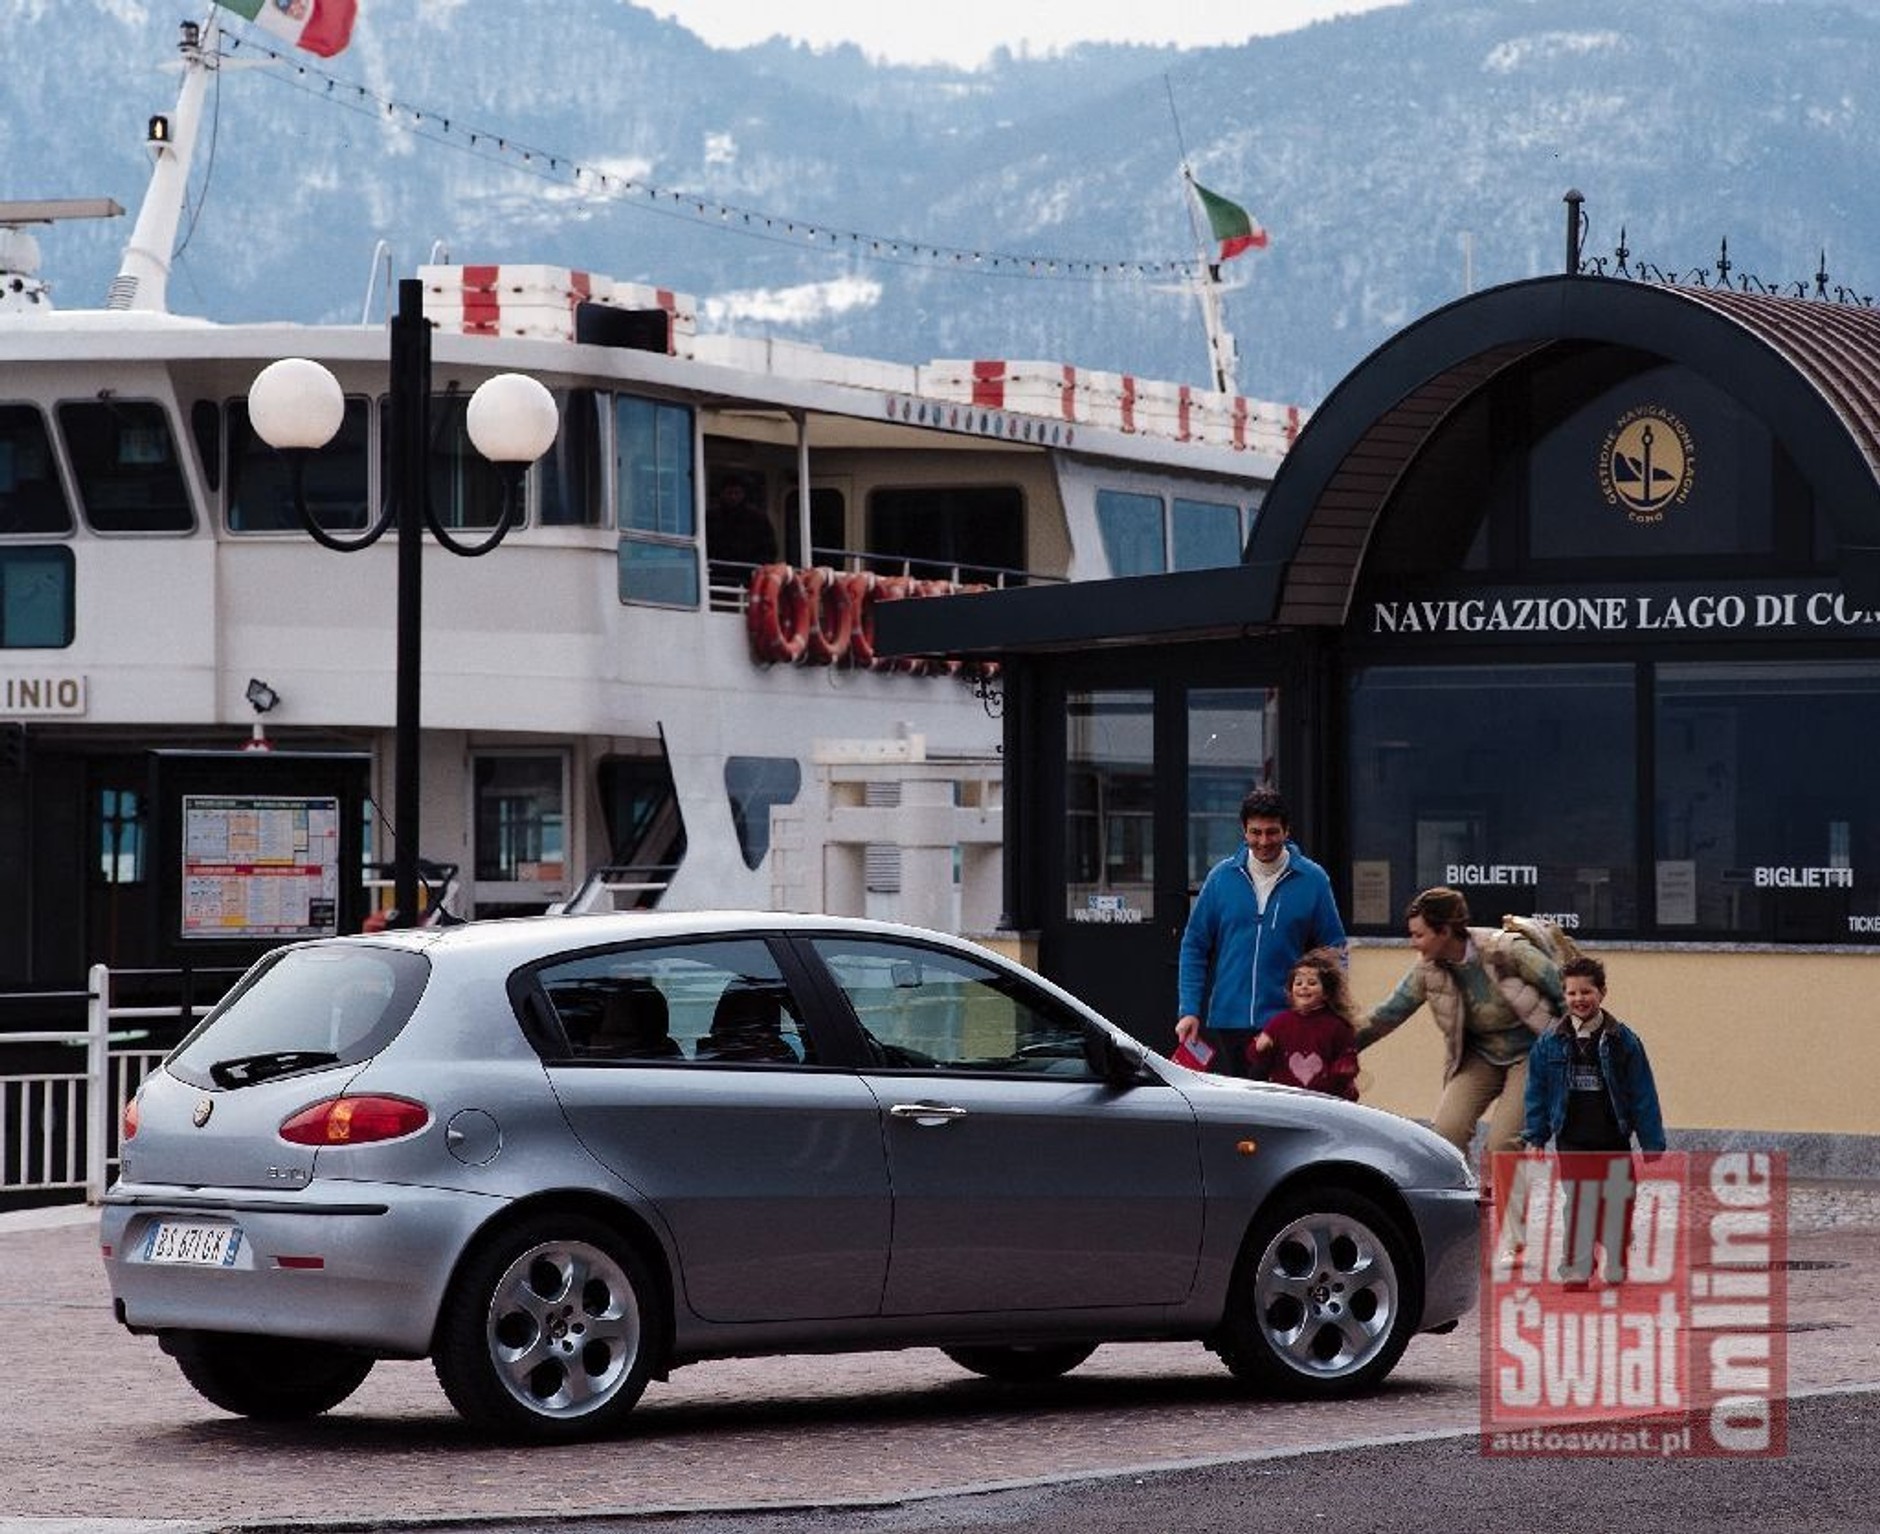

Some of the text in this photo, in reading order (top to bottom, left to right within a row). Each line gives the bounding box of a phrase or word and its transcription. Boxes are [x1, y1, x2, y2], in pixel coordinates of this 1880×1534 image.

[1374, 592, 1880, 631] NAVIGAZIONE LAGO DI CO
[1445, 864, 1538, 886] BIGLIETTI
[1755, 866, 1854, 888] BIGLIETTI
